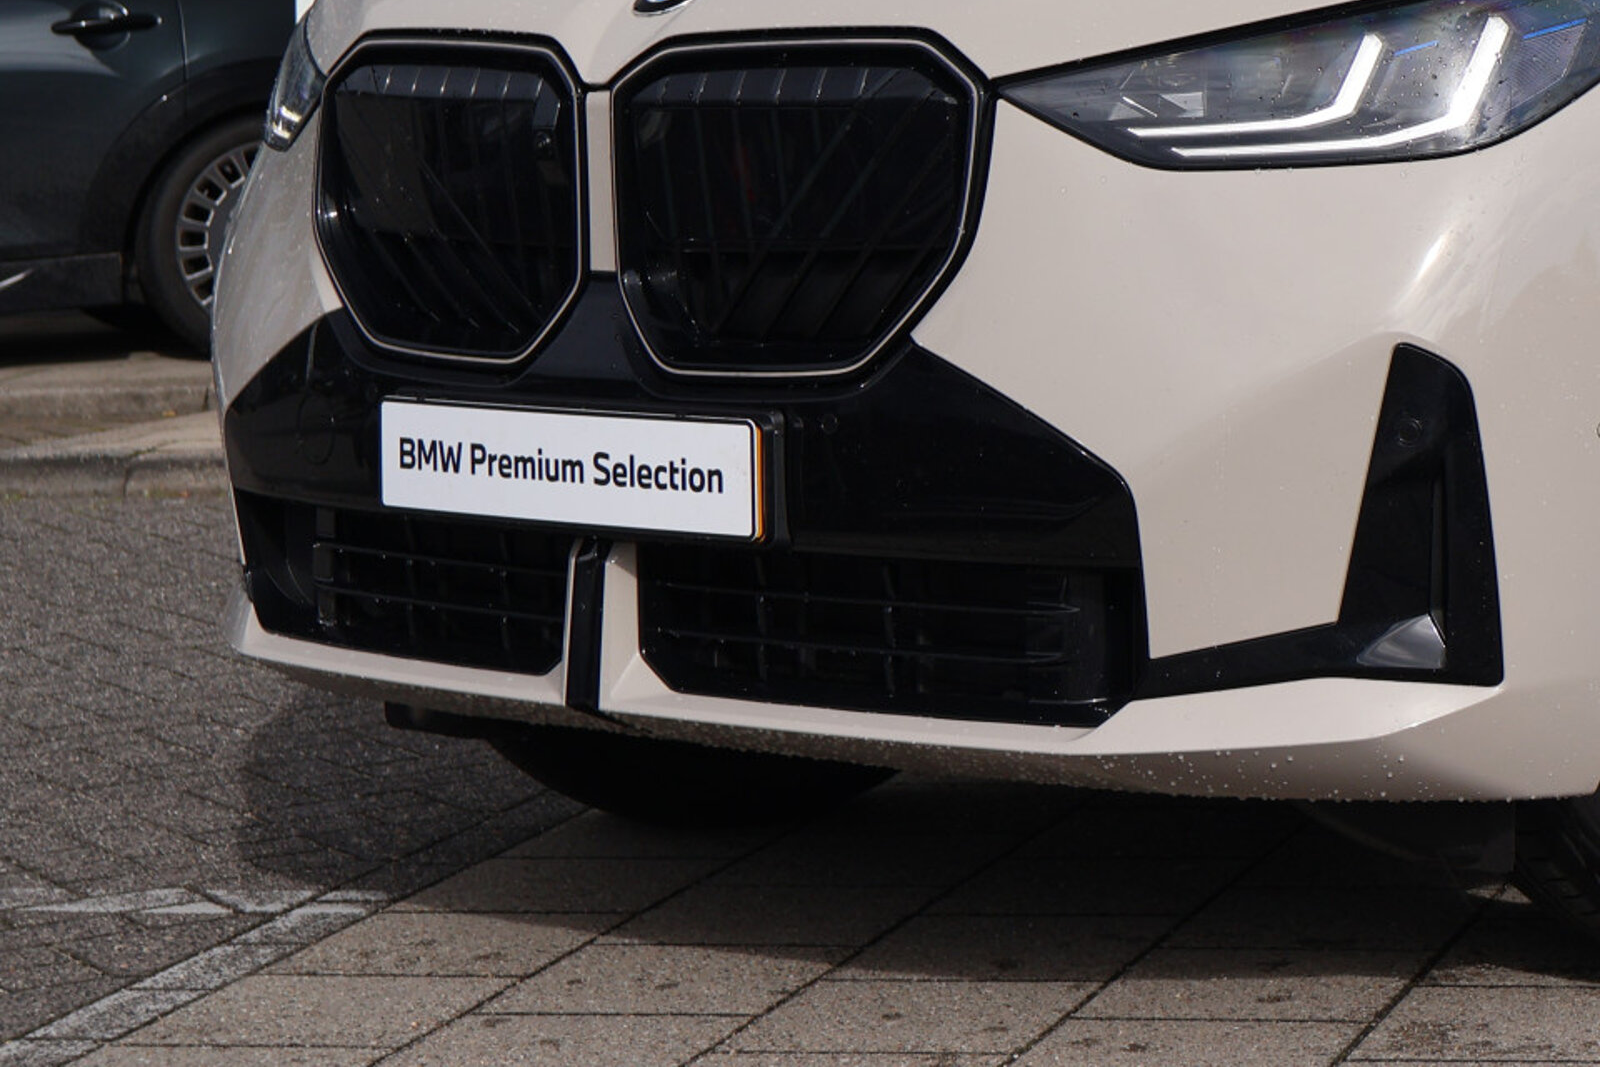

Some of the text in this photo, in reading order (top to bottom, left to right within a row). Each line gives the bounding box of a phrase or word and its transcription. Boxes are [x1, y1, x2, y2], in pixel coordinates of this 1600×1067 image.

[400, 436, 725, 495] BMW Premium Selection
